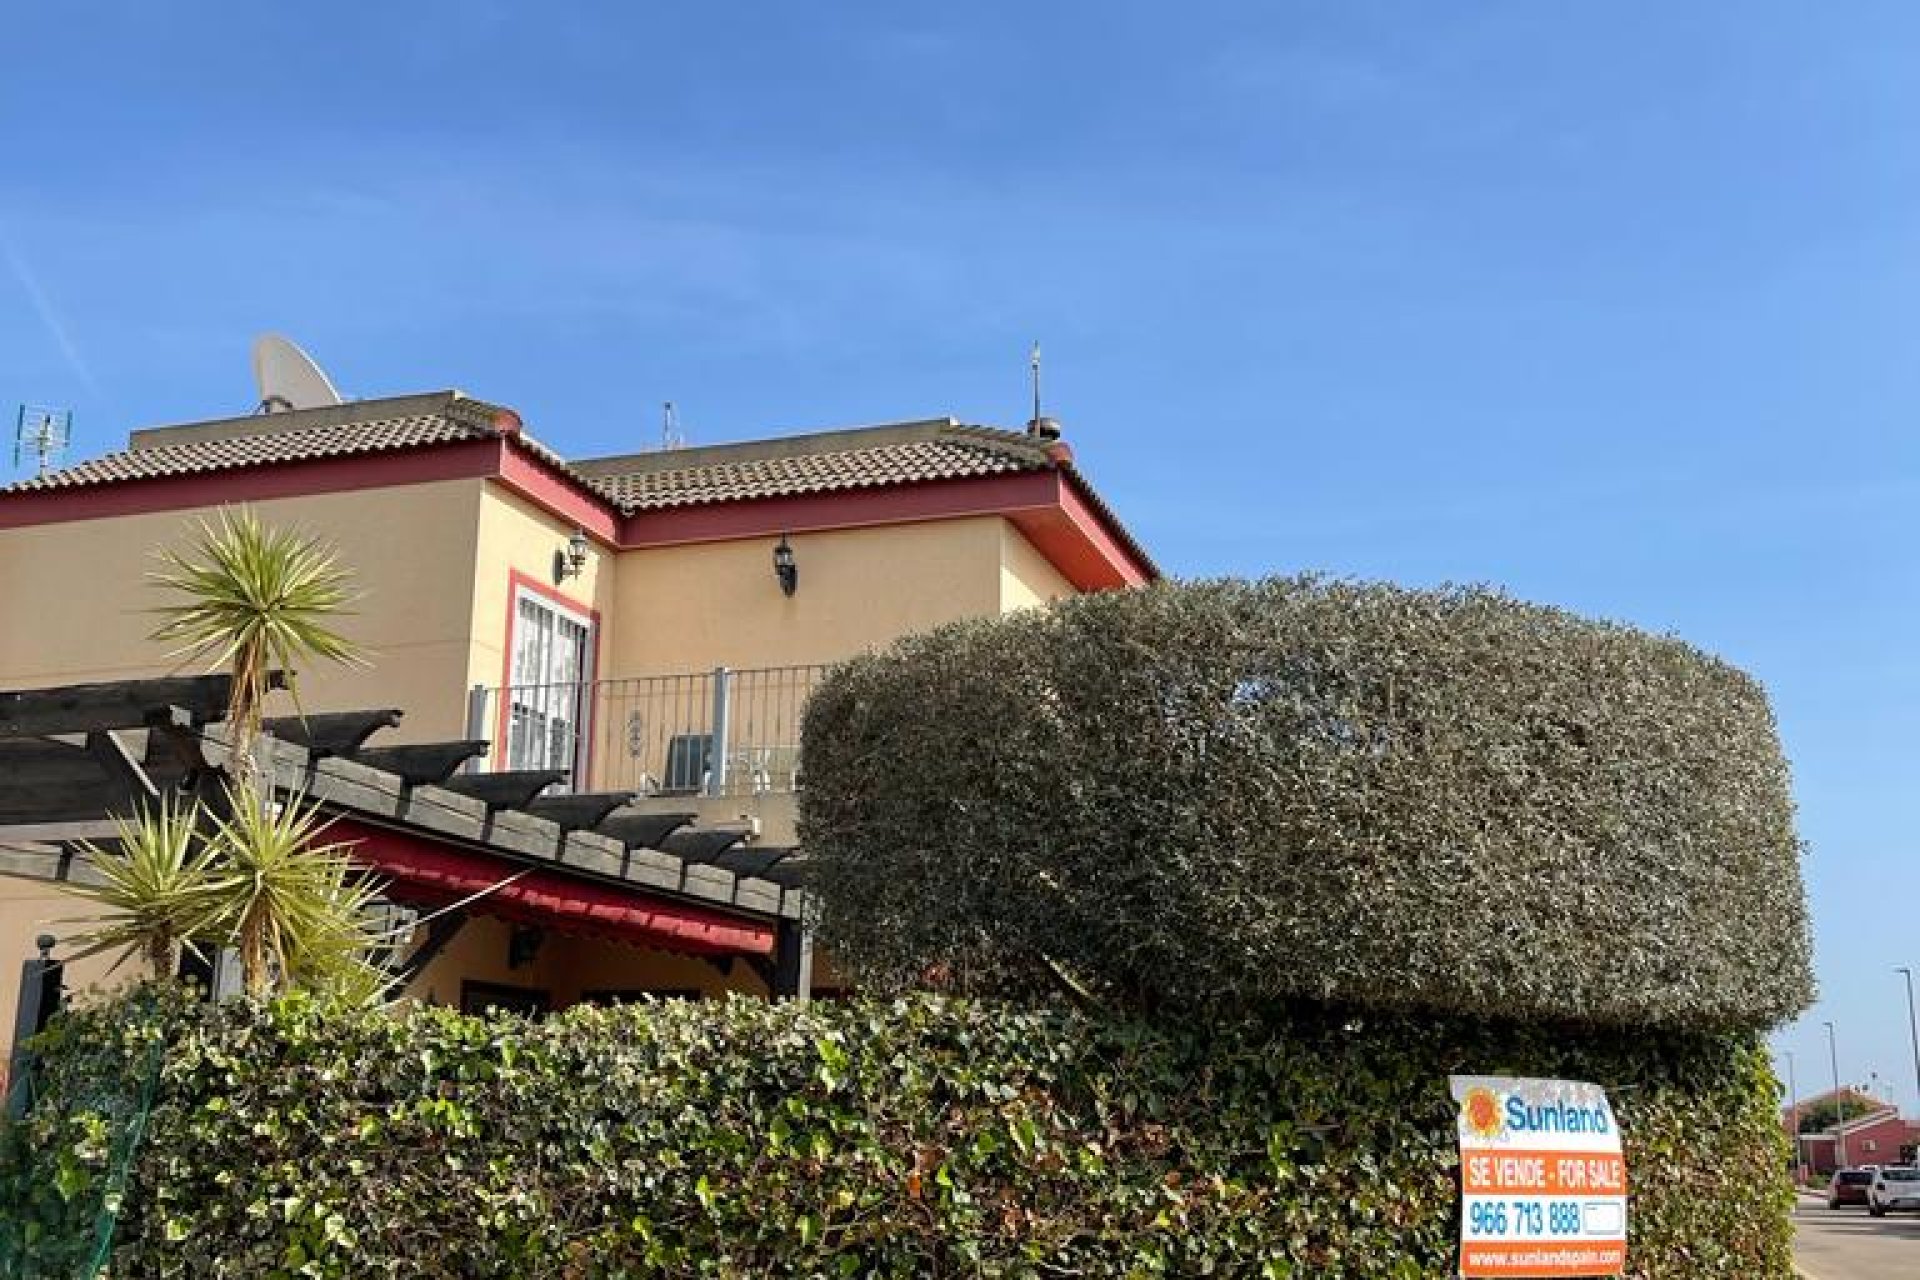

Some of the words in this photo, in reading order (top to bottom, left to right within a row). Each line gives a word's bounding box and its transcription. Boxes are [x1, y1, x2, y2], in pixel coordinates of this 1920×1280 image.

[1506, 1096, 1608, 1133] Sunland
[1469, 1157, 1491, 1187] SE
[1494, 1157, 1545, 1187] VENDE
[1557, 1159, 1586, 1188] FOR
[1589, 1159, 1621, 1189] SALE
[1469, 1201, 1507, 1236] 966
[1512, 1201, 1543, 1236] 713
[1549, 1201, 1580, 1235] 888
